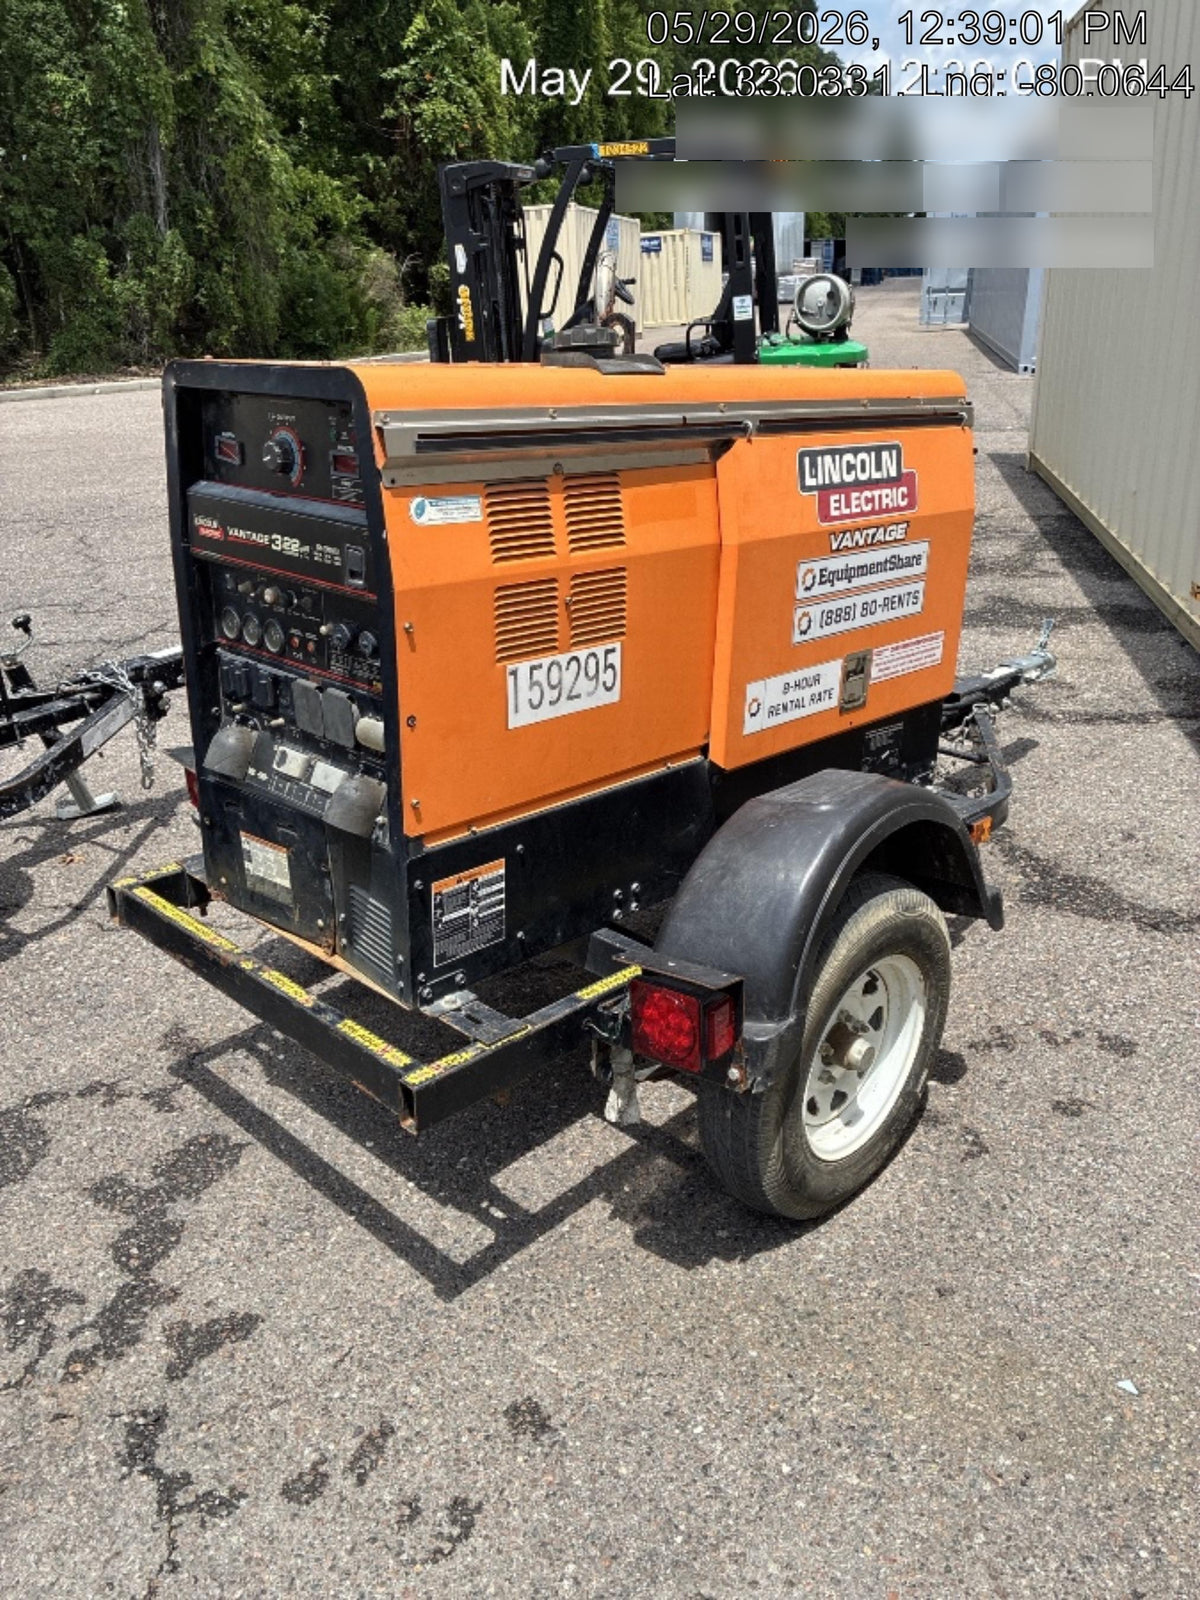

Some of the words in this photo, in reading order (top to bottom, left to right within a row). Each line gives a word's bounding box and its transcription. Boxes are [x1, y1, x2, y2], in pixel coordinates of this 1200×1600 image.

[803, 450, 898, 487] LINCOLN
[829, 486, 909, 517] ELECTRIC
[226, 526, 270, 545] VANTAGE
[271, 533, 300, 552] 322
[829, 522, 910, 552] VANTAGE
[818, 554, 923, 588] EquipmentShare
[819, 601, 857, 629] (888)
[508, 646, 618, 715] 159295
[782, 673, 822, 696] 8-HOUR
[767, 696, 806, 719] RENTAL
[808, 687, 835, 706] RATE
